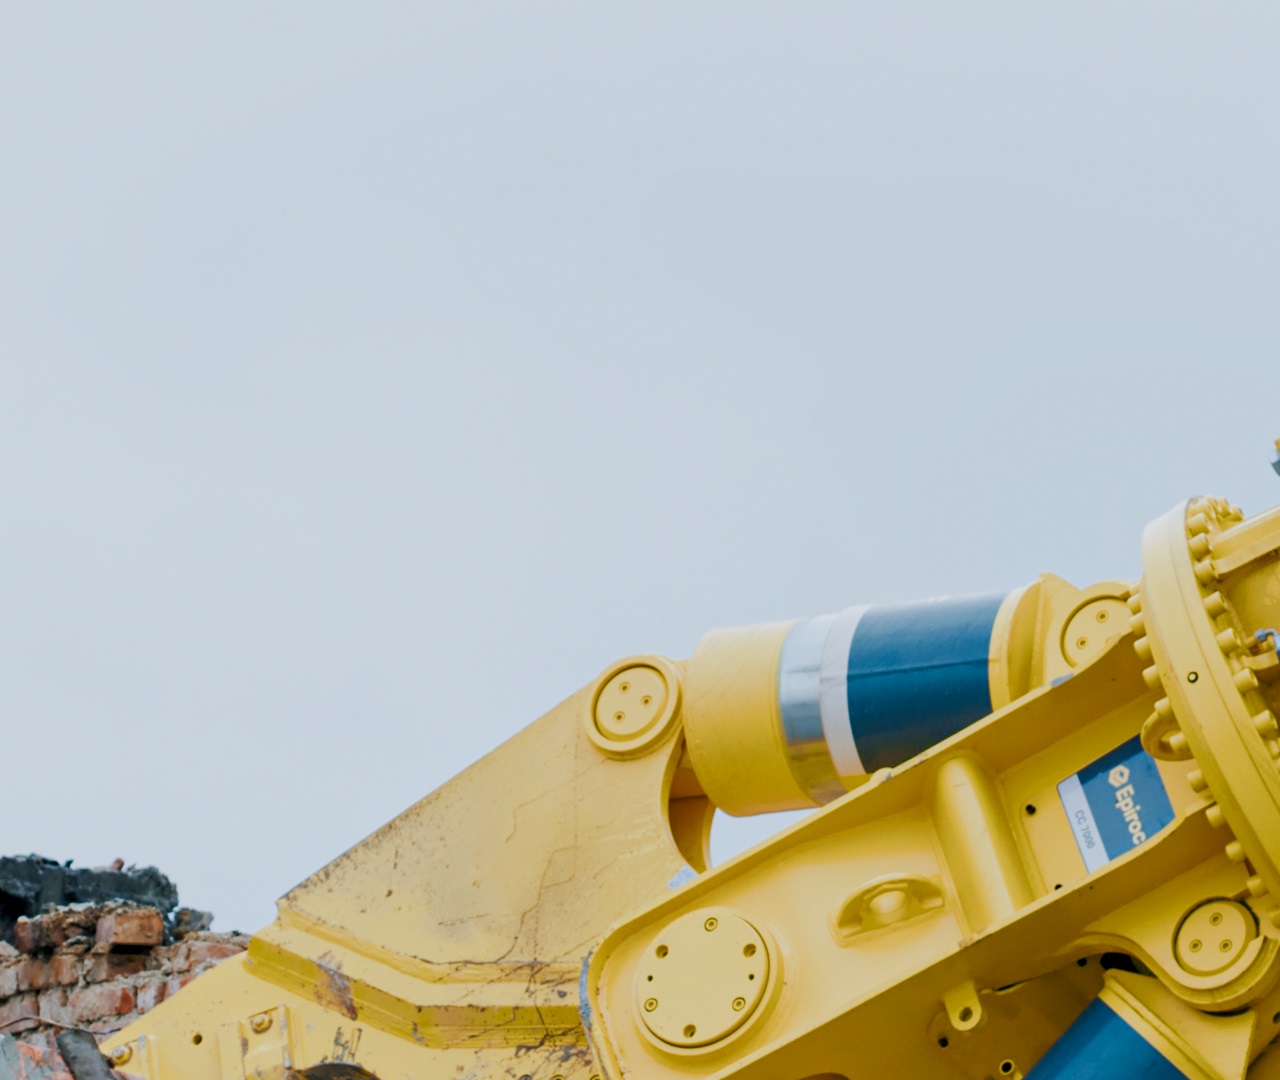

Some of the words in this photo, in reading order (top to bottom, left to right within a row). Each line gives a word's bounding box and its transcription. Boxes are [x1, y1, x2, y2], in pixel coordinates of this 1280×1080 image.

[1075, 809, 1087, 825] CC
[1115, 783, 1146, 845] Epiroc
[1080, 825, 1095, 849] 7000
